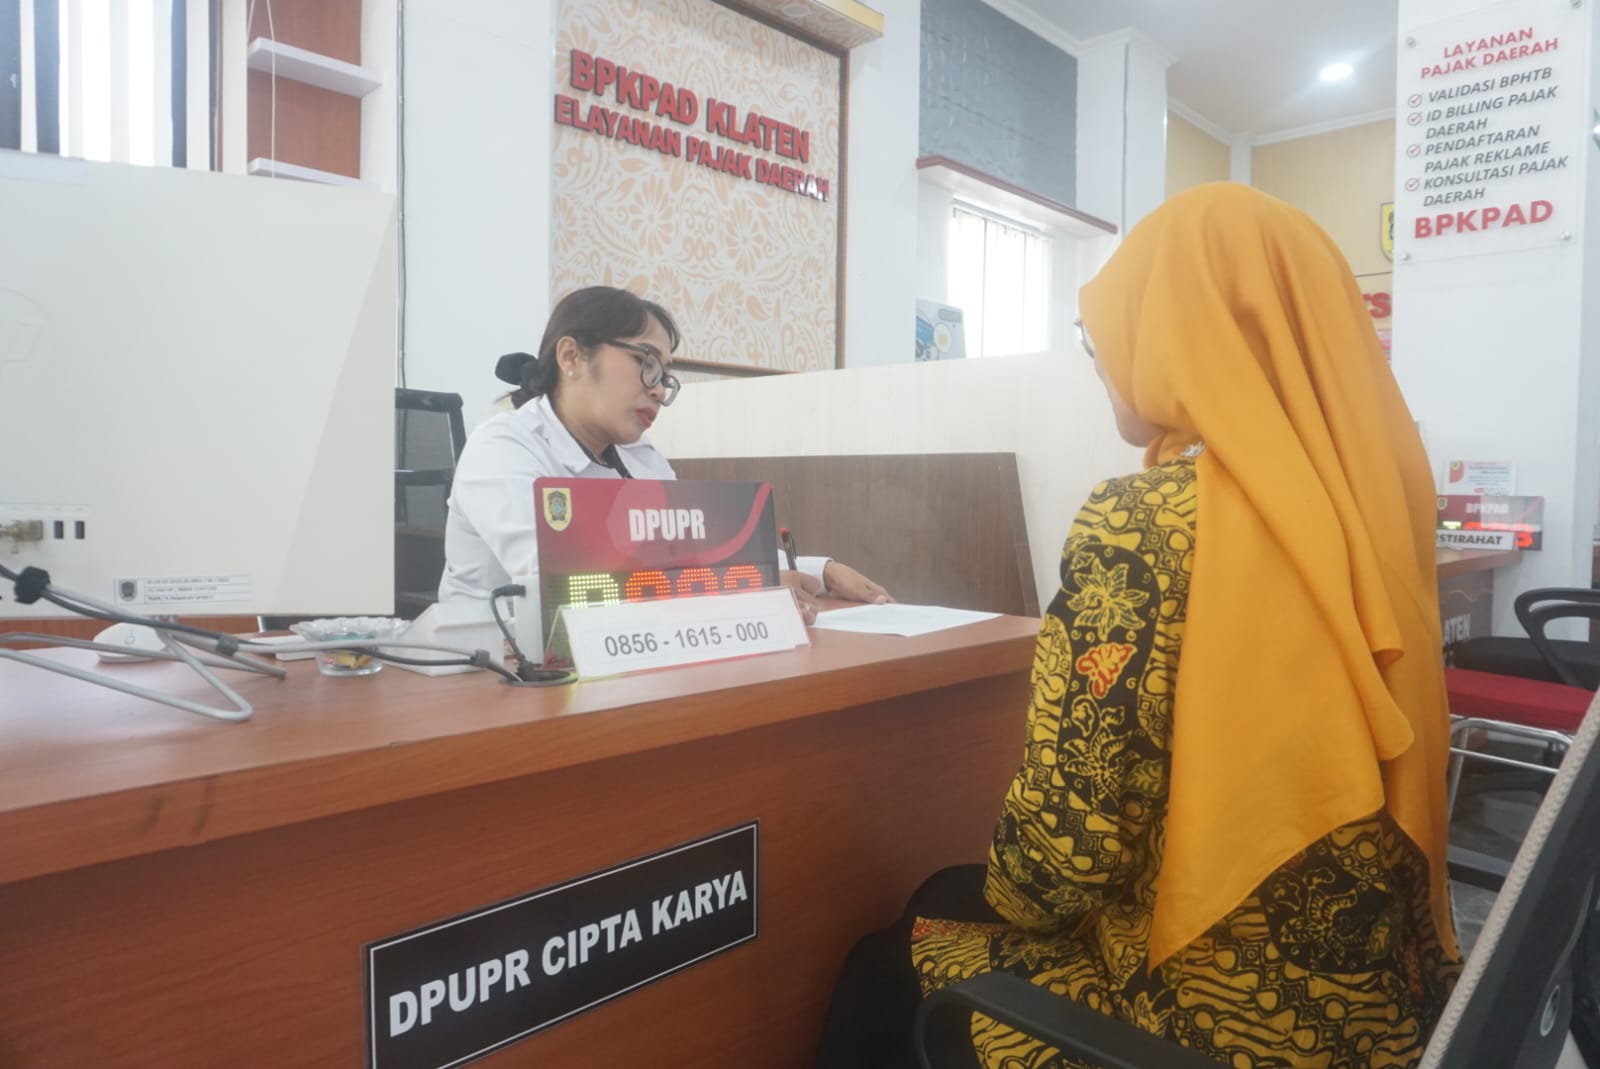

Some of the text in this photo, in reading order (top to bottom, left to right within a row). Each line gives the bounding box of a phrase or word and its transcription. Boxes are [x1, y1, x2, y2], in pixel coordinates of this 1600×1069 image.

[1421, 37, 1559, 79] PAJAK DAERAH
[1443, 27, 1533, 59] LAYANAN
[1428, 66, 1553, 103] VALIDASI BPHTB
[570, 49, 810, 164] BPKPAD KLATEN
[1426, 85, 1558, 123] ID BILLING PAJAK
[1424, 125, 1541, 156] PENDAFTARAN
[1425, 117, 1489, 140] DAERAH
[554, 94, 830, 203] ELAYANAN PAJAK DAERAH
[1424, 141, 1551, 174] PAJAK REKLAME
[1424, 155, 1569, 191] KONSULTASI PAJAK
[1423, 187, 1486, 207] DAERAH
[1414, 199, 1553, 239] BPKPAD
[628, 509, 706, 541] DPUPR
[606, 632, 659, 657] 0856
[675, 626, 722, 648] 1615
[736, 622, 768, 642] 000
[389, 869, 748, 1038] DPUPR CIPTA KARYA
